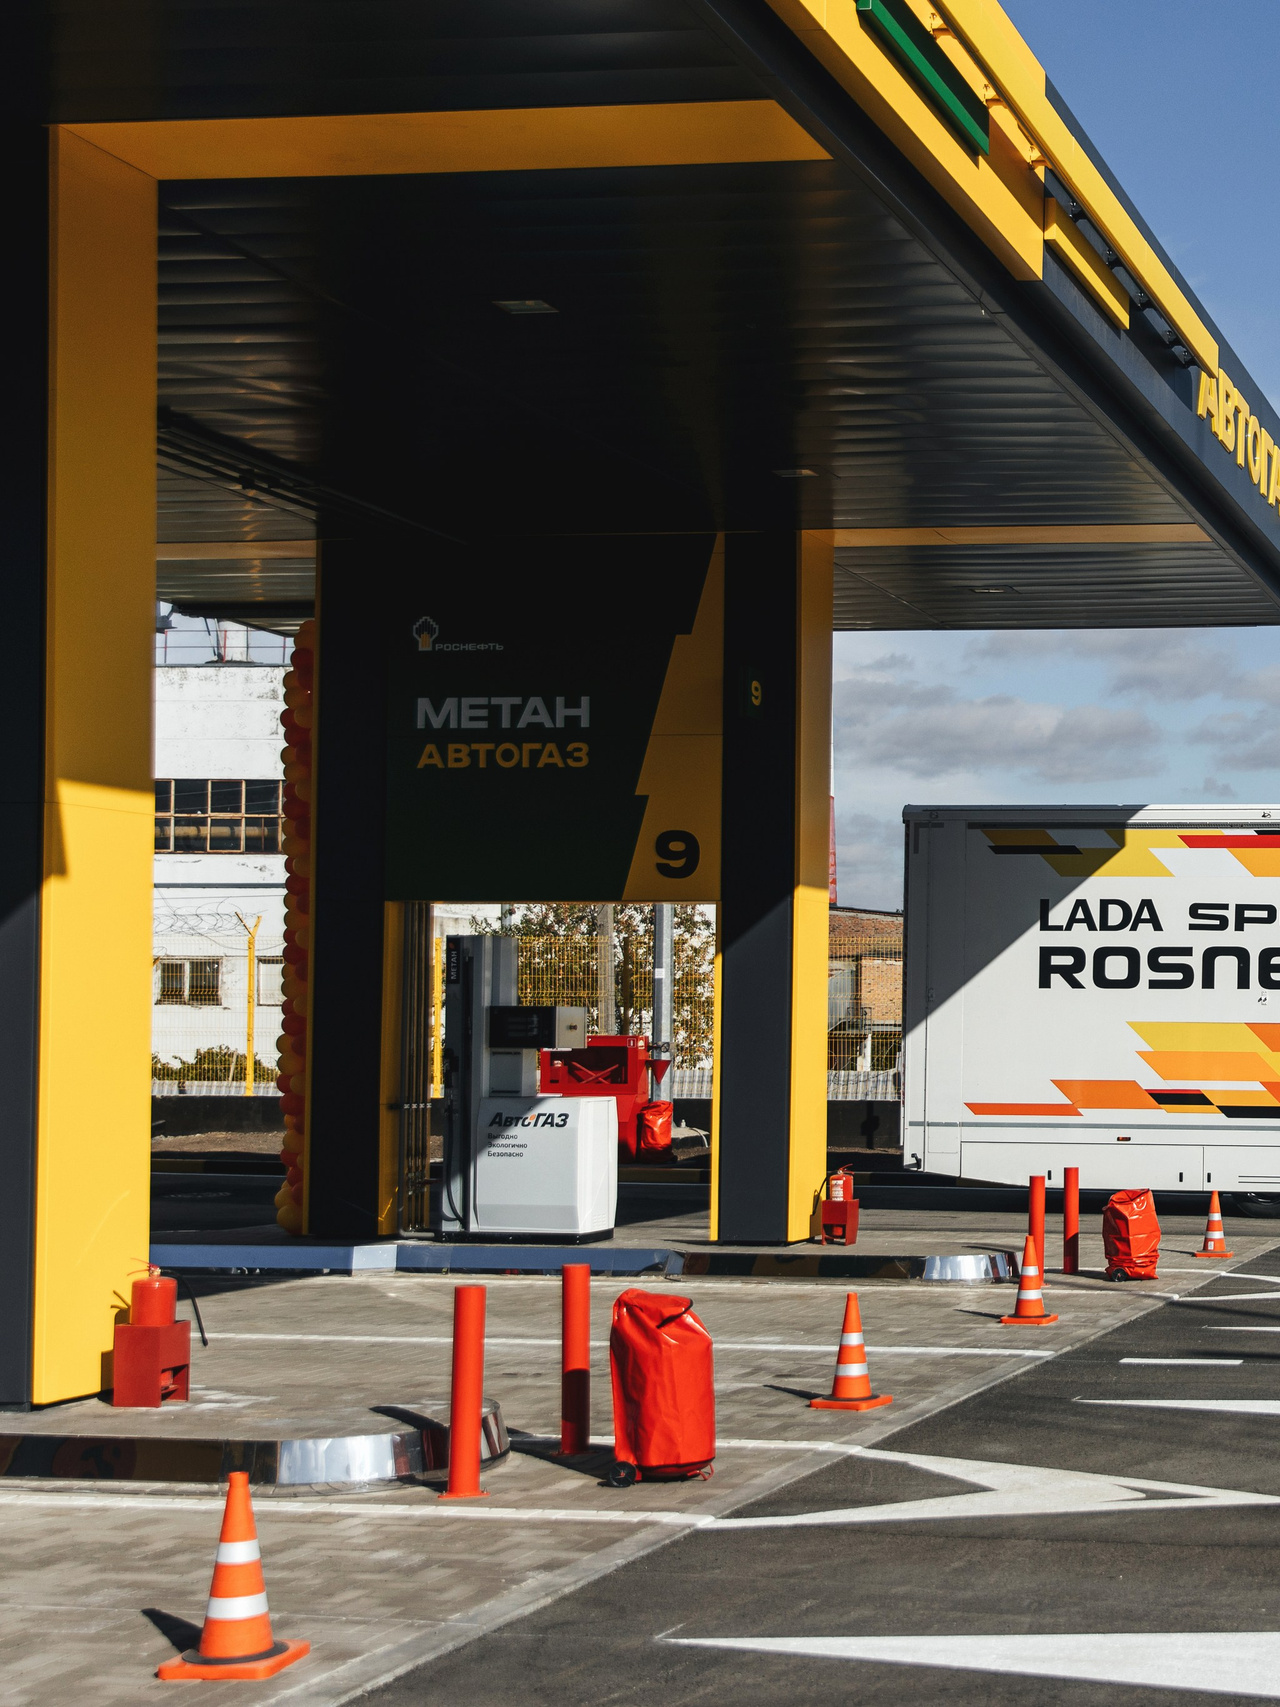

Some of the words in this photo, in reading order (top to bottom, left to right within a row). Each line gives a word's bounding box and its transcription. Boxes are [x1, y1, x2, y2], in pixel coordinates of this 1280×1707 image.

[435, 643, 504, 651] РОСНЕФТЬ
[751, 680, 762, 706] 9
[416, 696, 590, 729] МЕТАН
[416, 742, 590, 769] АВТОГАЗ
[654, 829, 700, 879] 9
[1038, 898, 1164, 932] LADA
